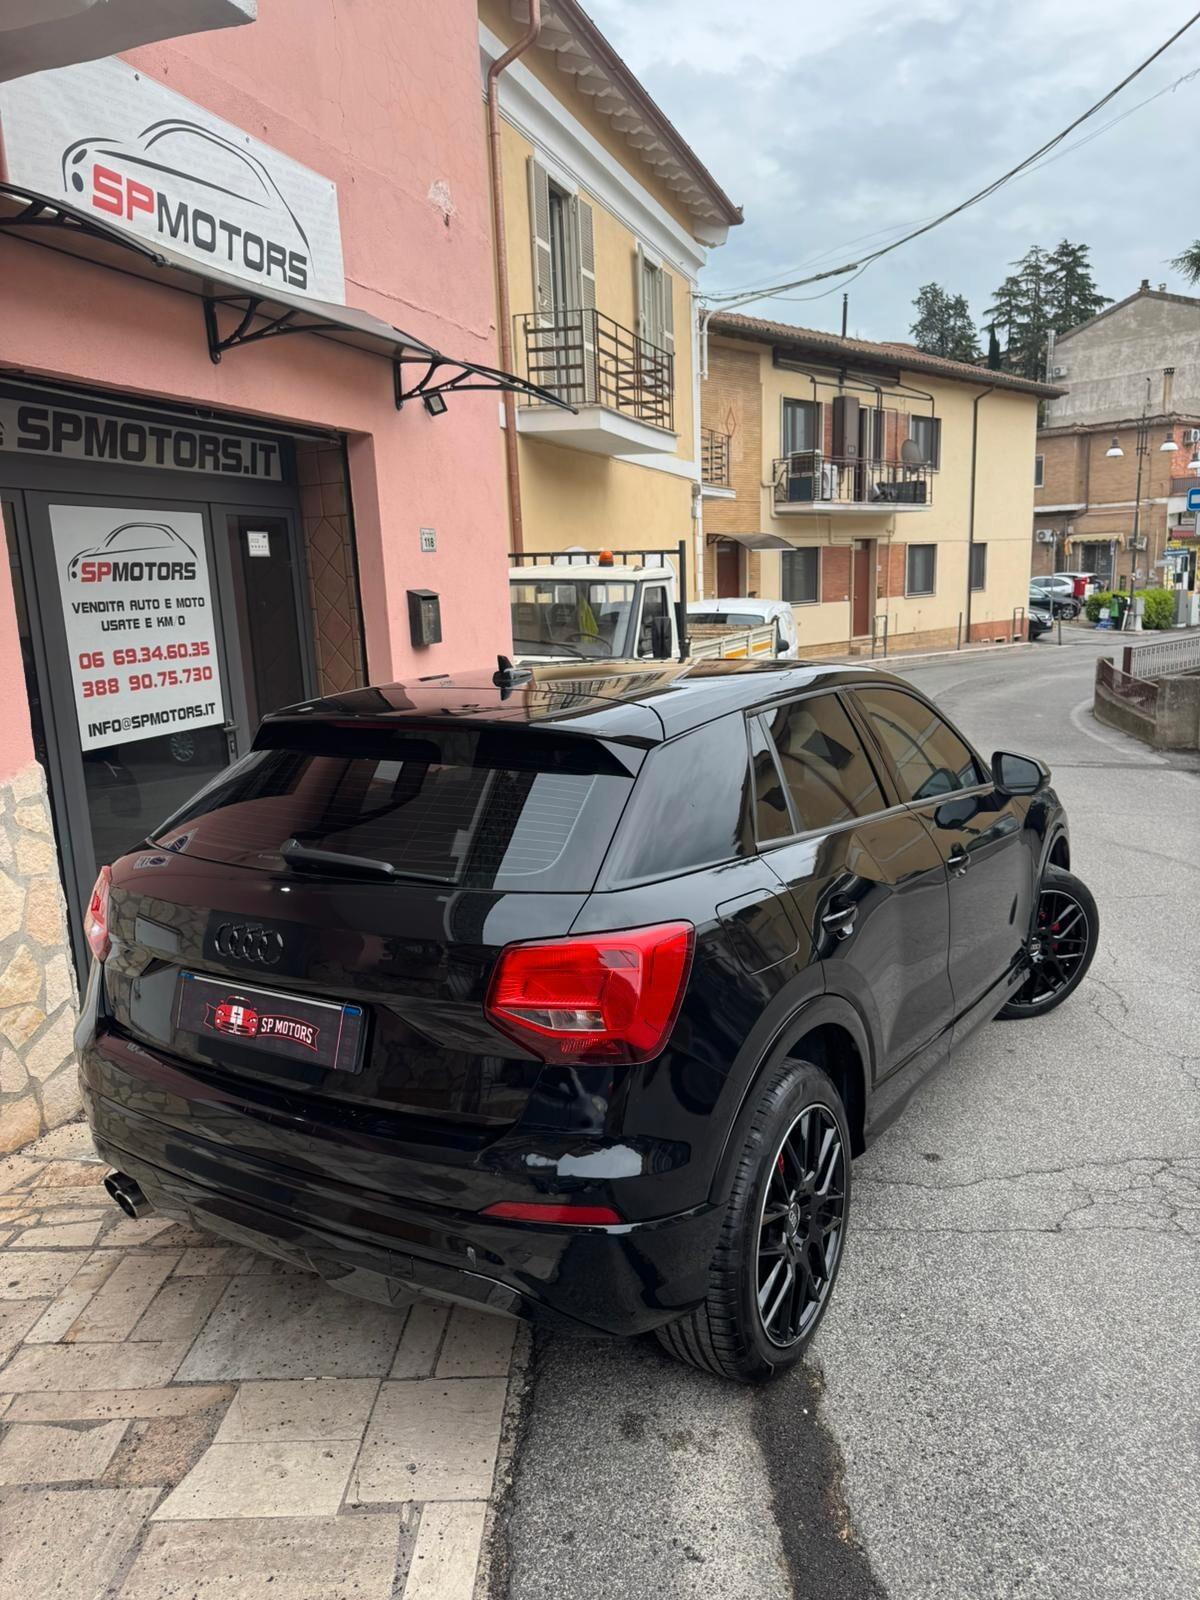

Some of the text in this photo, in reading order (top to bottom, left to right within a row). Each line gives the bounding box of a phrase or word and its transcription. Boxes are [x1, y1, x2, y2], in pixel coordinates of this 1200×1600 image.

[17, 406, 277, 477] SPMOTORS.IT
[72, 597, 205, 614] VENDITA AUTO E MOTO
[101, 618, 140, 632] USATE
[145, 617, 152, 628] E
[157, 616, 173, 627] KM
[78, 641, 210, 670] 06 69.34.60.35
[82, 666, 213, 698] 388 90.75.730
[88, 703, 216, 737] INFO@SPMOTORS.IT
[261, 1017, 313, 1044] SP MOTORS
